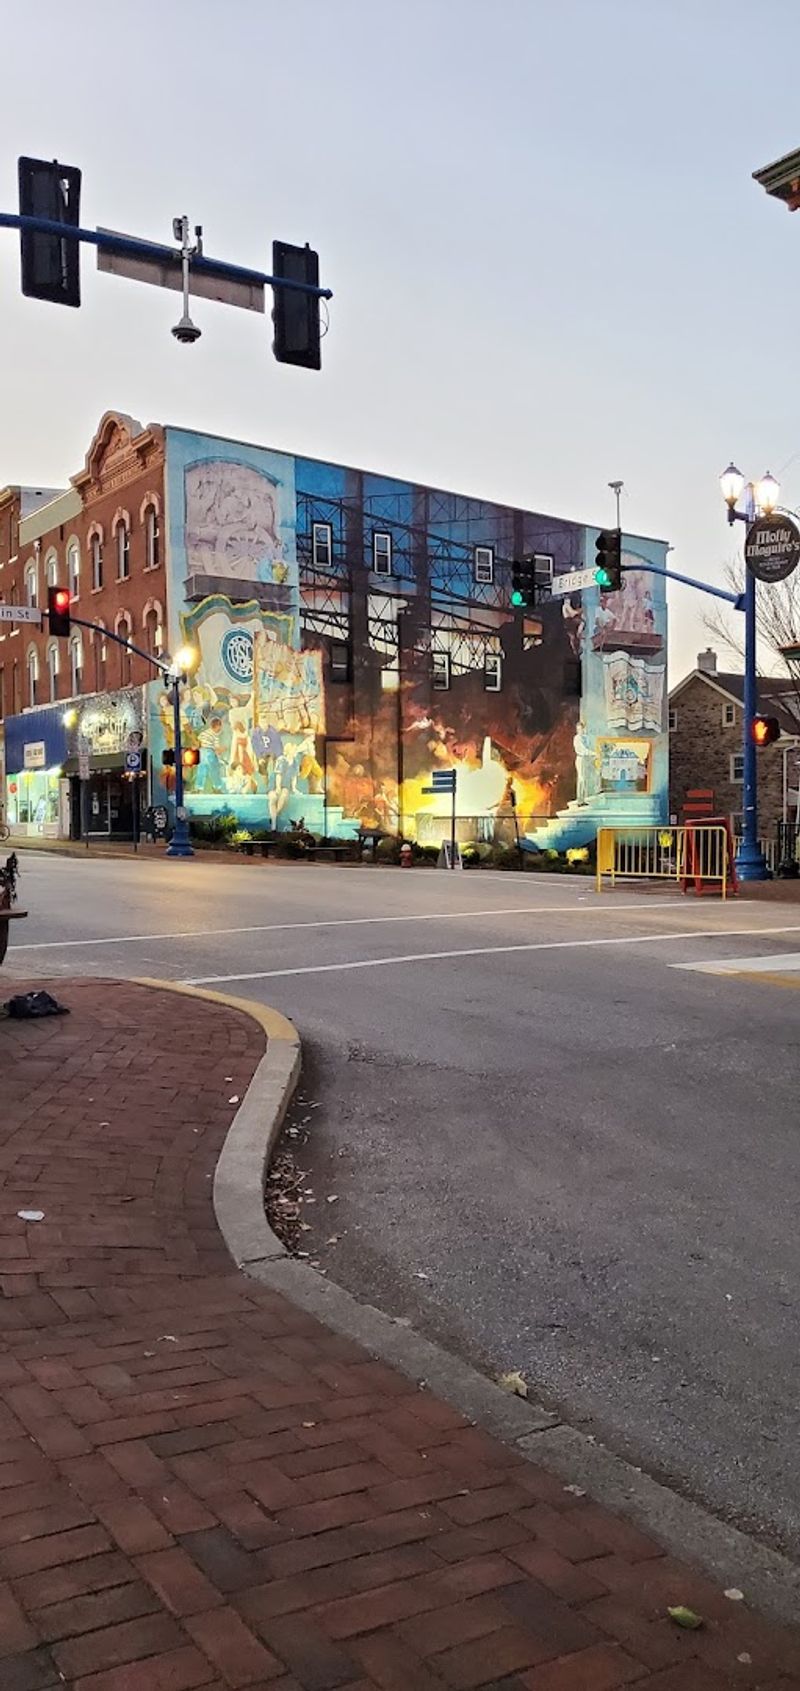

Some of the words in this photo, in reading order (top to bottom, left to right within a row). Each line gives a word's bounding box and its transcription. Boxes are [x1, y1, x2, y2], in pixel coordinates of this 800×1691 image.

[756, 529, 791, 544] Molly
[746, 540, 800, 557] Maguire's
[1, 608, 12, 618] in
[17, 610, 29, 619] St
